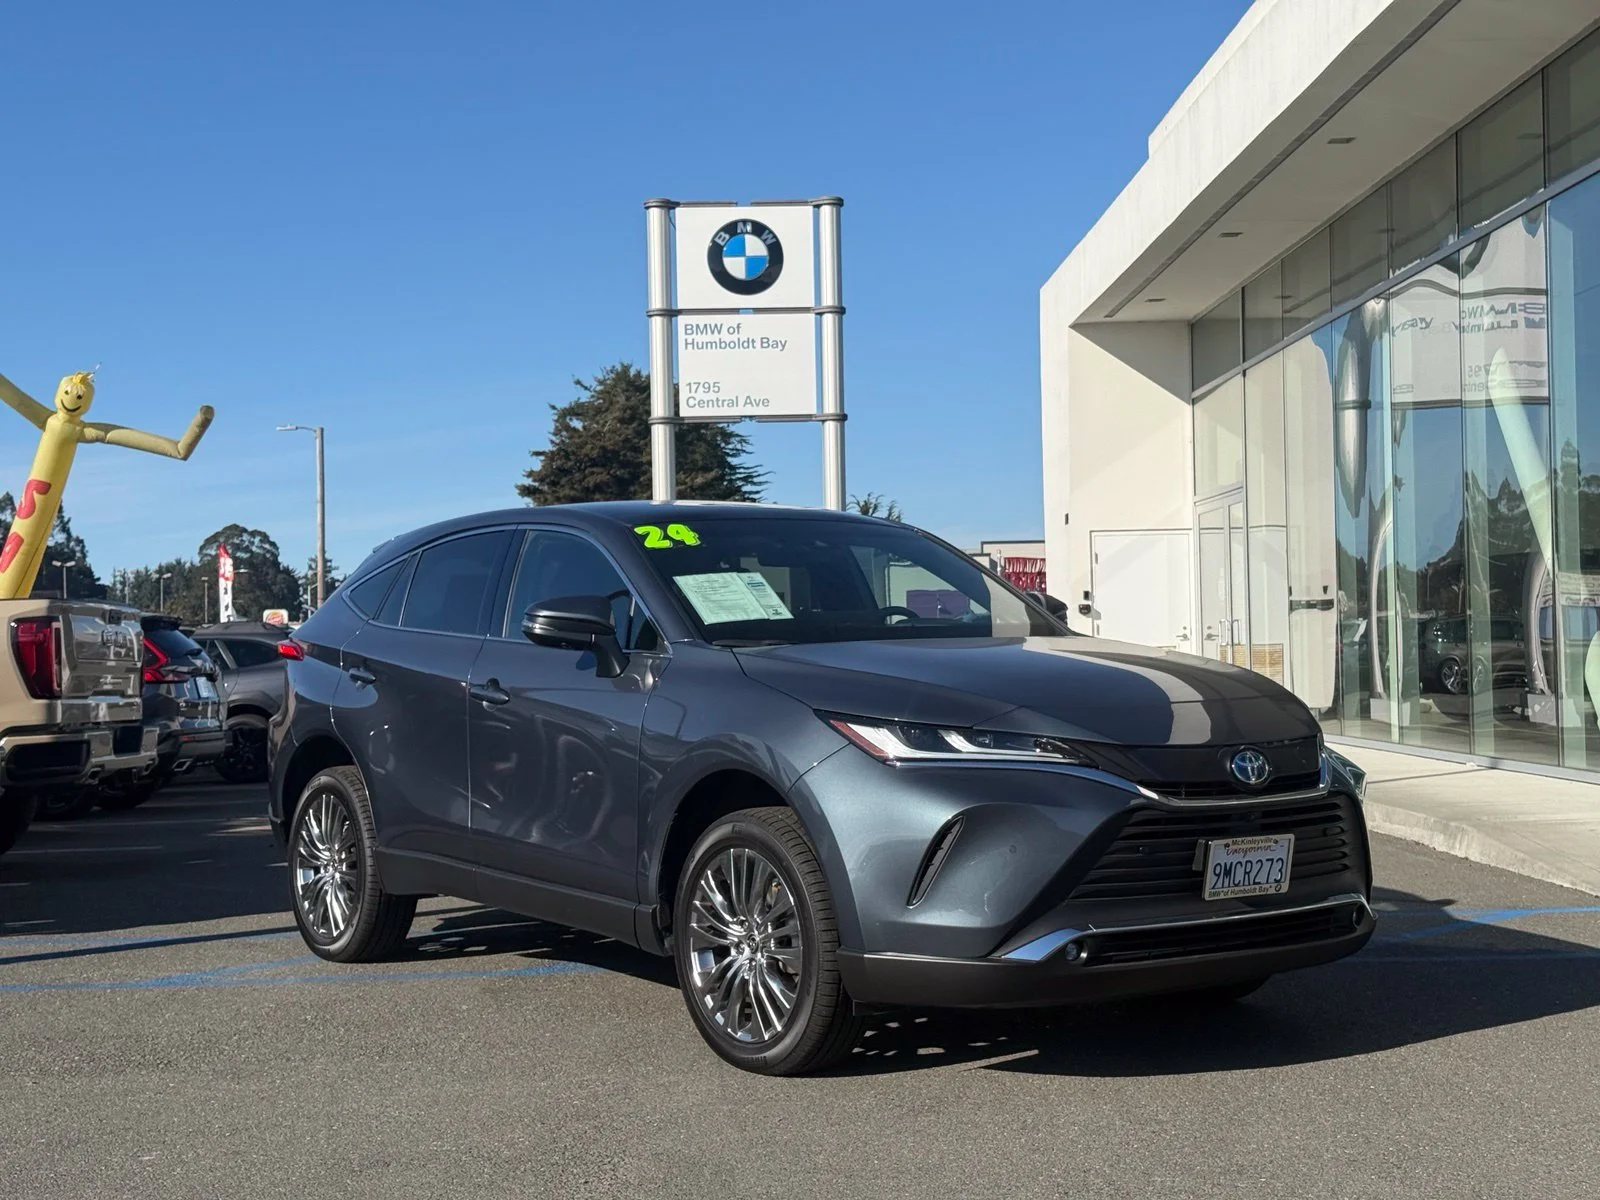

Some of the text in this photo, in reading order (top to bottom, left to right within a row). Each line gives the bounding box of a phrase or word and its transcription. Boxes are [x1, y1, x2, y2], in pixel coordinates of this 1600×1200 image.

[714, 221, 776, 246] BMW
[684, 323, 742, 336] BMW of
[684, 337, 788, 351] Humboldt Bay
[686, 382, 720, 394] 1795
[686, 396, 770, 409] Central Ave
[634, 523, 701, 549] 24
[1212, 858, 1284, 889] 9MCR273
